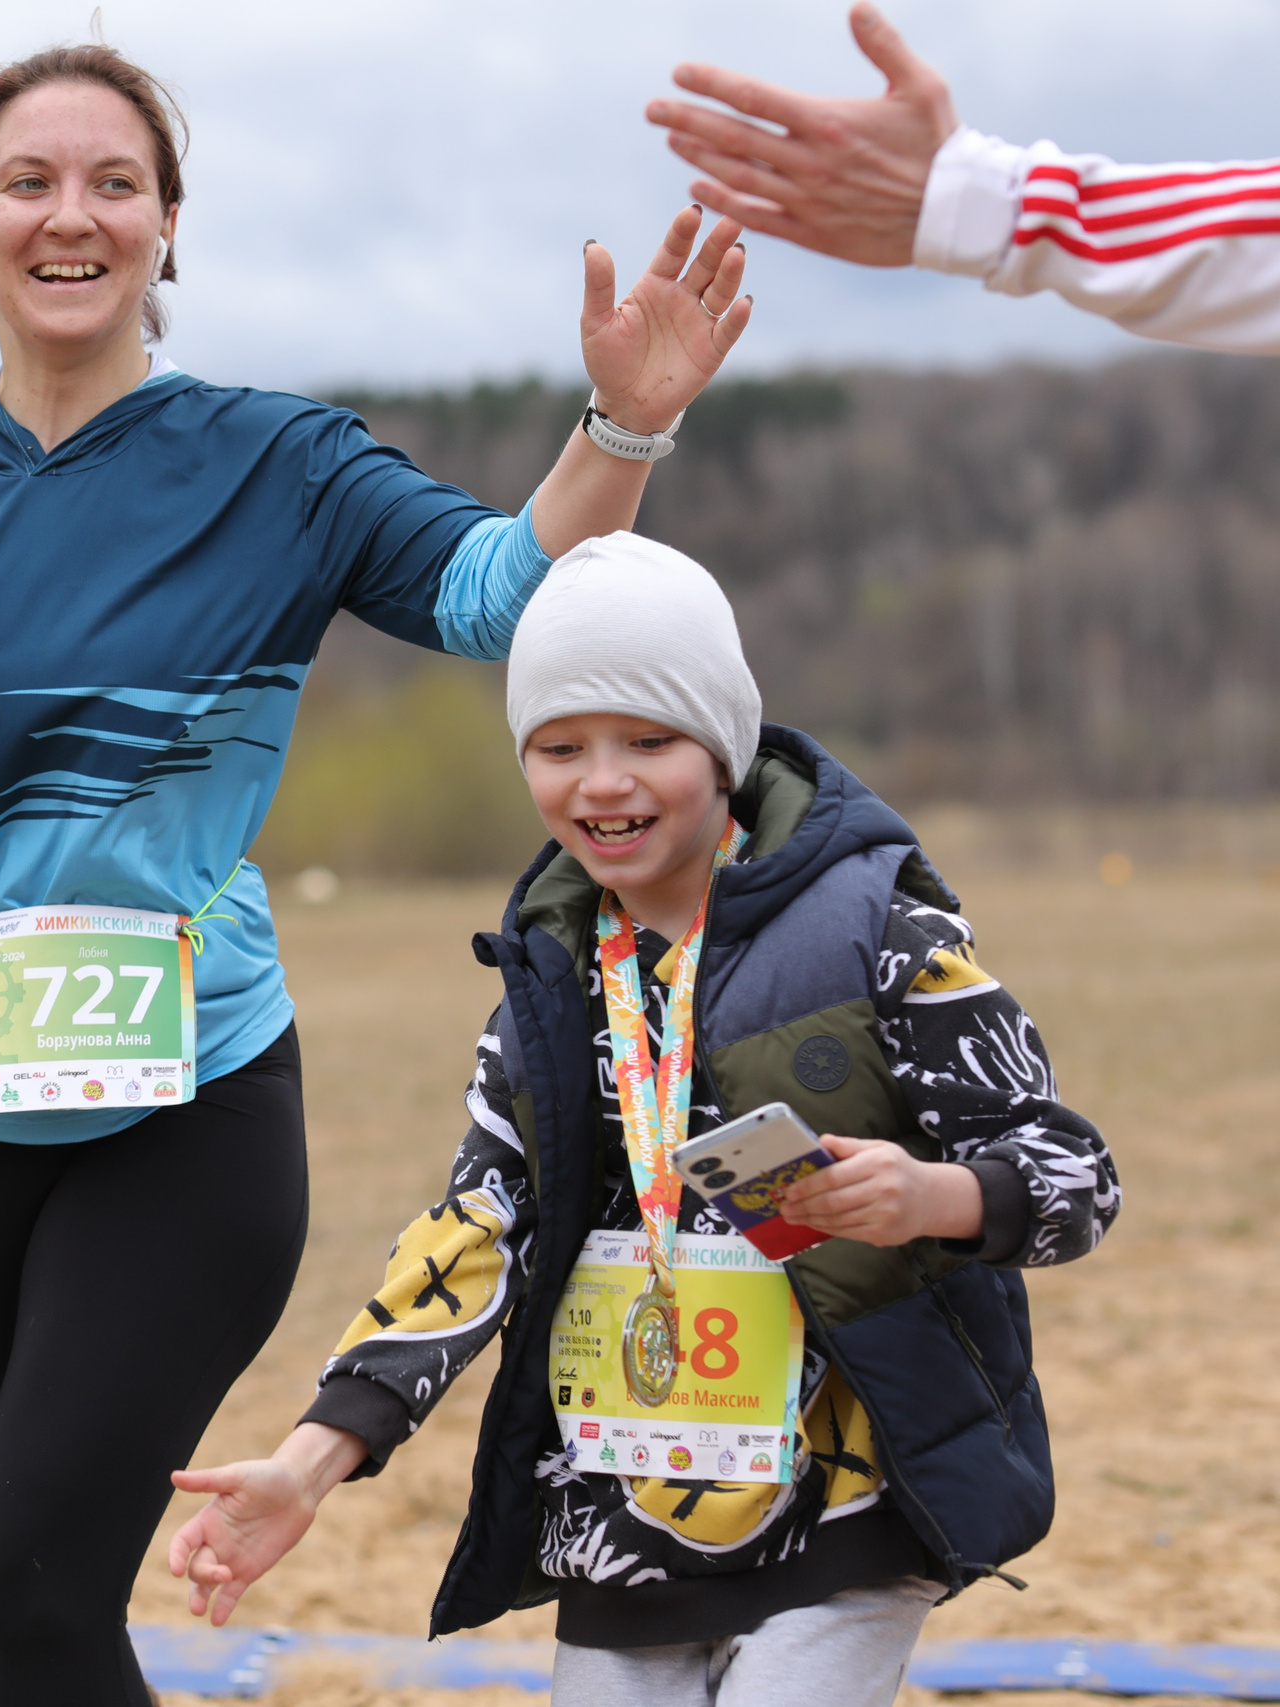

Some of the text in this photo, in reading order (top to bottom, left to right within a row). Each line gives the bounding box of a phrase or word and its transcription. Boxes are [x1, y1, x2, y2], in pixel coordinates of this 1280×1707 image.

[35, 914, 144, 931] ХИМКИНСКИЙ
[147, 921, 173, 936] ЛЕС
[2, 951, 26, 963] 2024
[78, 946, 109, 958] Лобня
[23, 964, 164, 1027] 727
[37, 1032, 151, 1051] Борзунова Анна
[13, 1072, 46, 1081] GEL4U
[624, 1041, 656, 1168] #ХИМКИНСКИЙ ЛЕС
[632, 1245, 746, 1267] ХИКИНСКИЙ
[607, 1284, 626, 1295] 2024
[569, 1308, 592, 1327] 1,10
[694, 1389, 760, 1408] Максим
[612, 1429, 637, 1438] GEL4U
